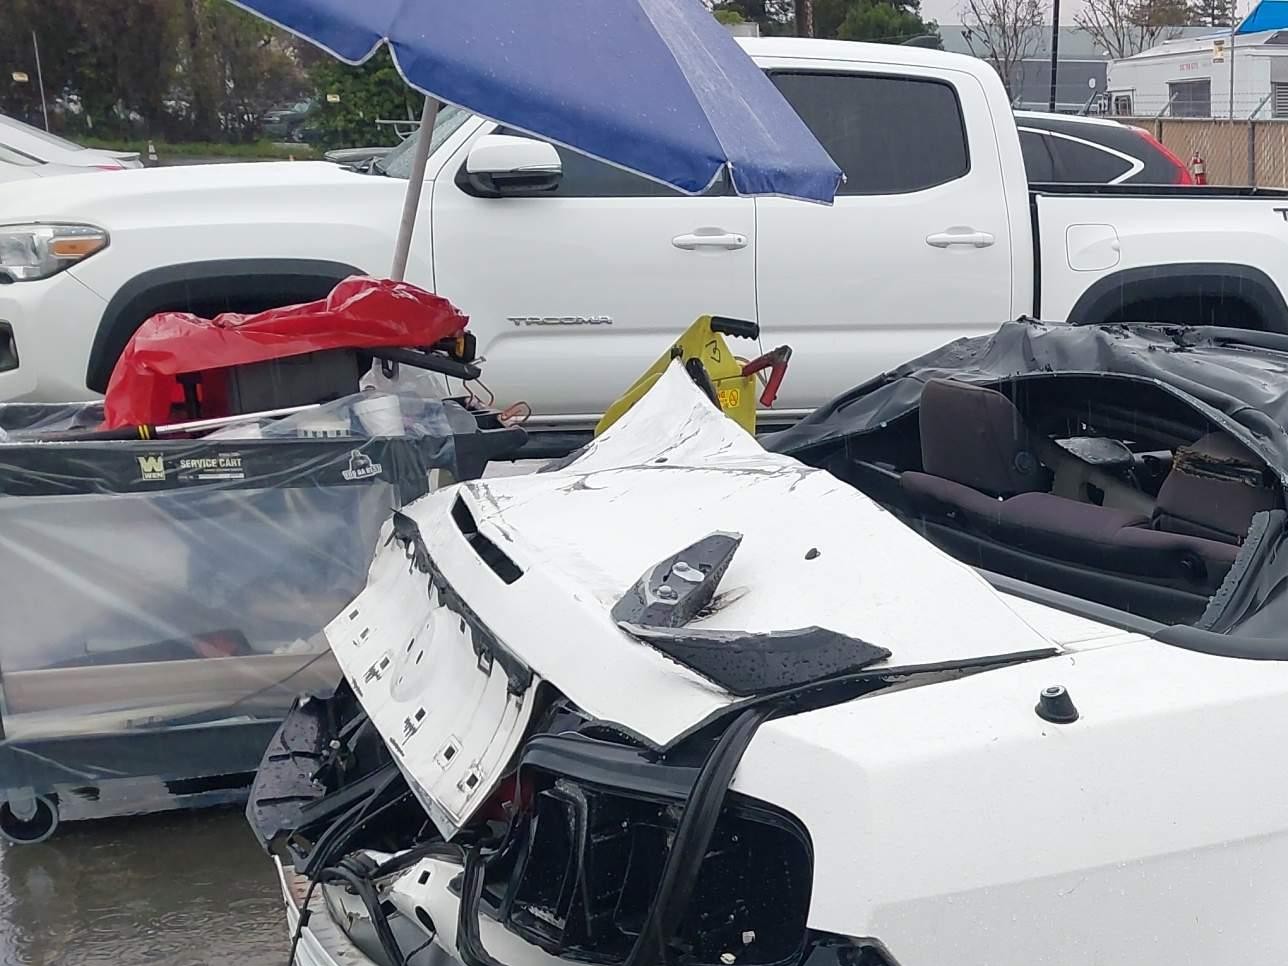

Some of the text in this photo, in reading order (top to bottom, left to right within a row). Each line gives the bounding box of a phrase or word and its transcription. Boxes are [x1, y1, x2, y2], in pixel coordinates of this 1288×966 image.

[506, 316, 613, 326] TACOMA
[180, 459, 242, 468] SERVICE CART
